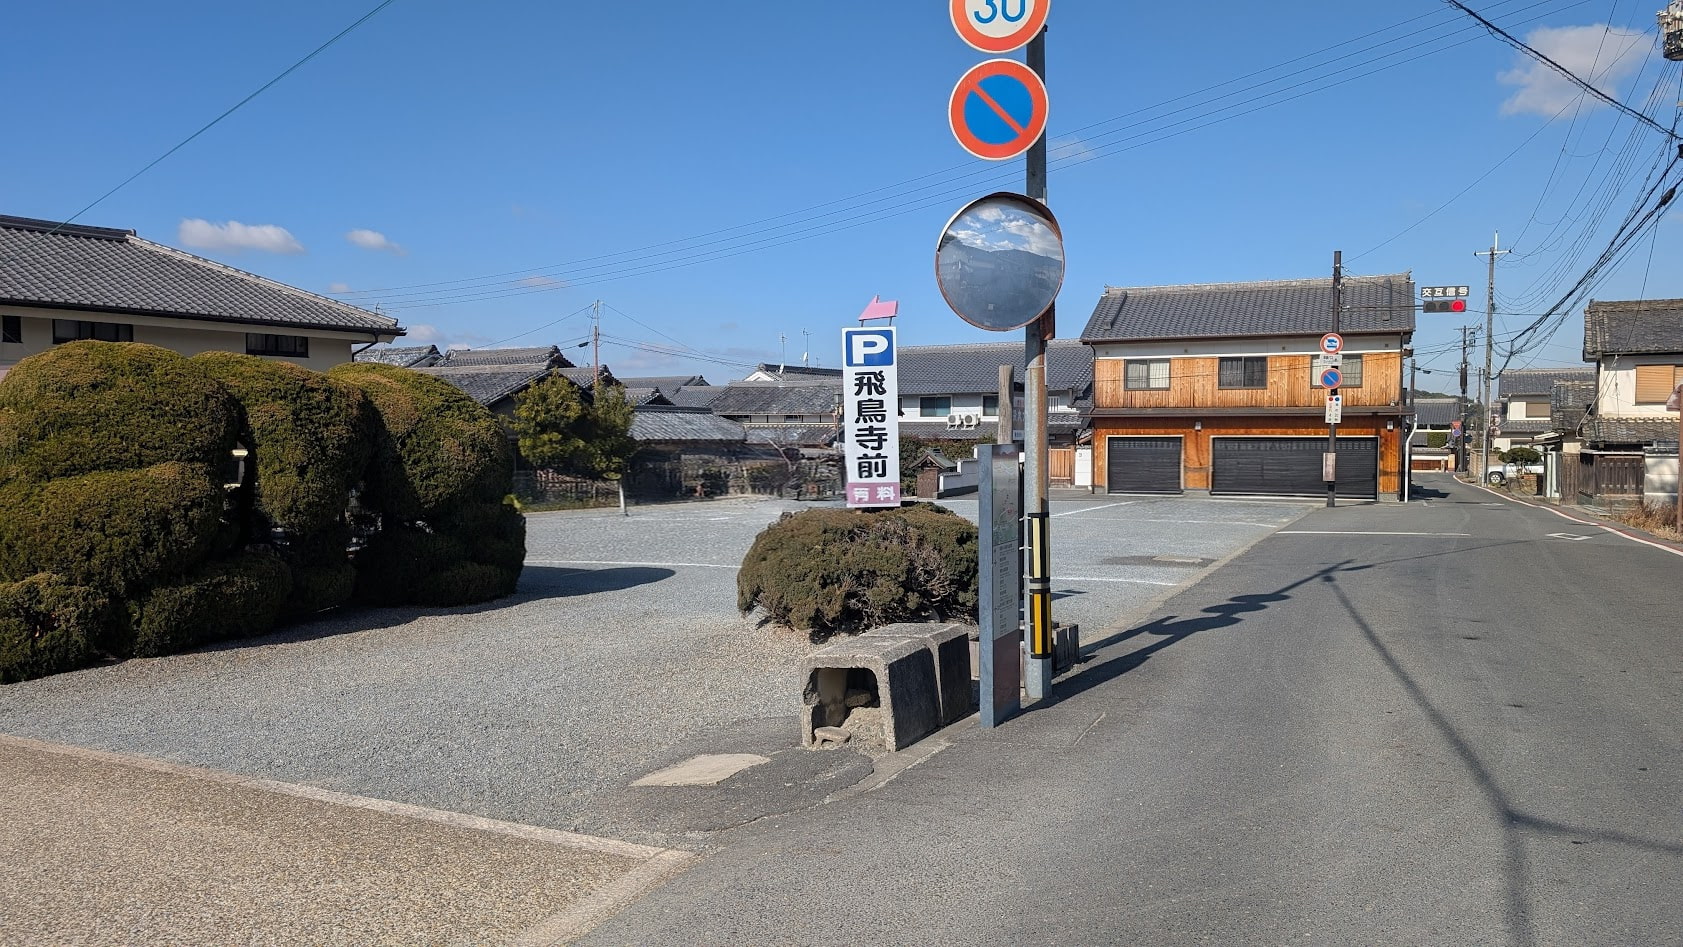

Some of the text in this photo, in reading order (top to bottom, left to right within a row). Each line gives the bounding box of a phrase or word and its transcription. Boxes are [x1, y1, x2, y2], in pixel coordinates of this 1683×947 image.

[974, 0, 1026, 24] 30
[1422, 286, 1468, 297] 交互信号
[851, 334, 889, 365] P
[854, 370, 888, 479] 飛鳥寺前
